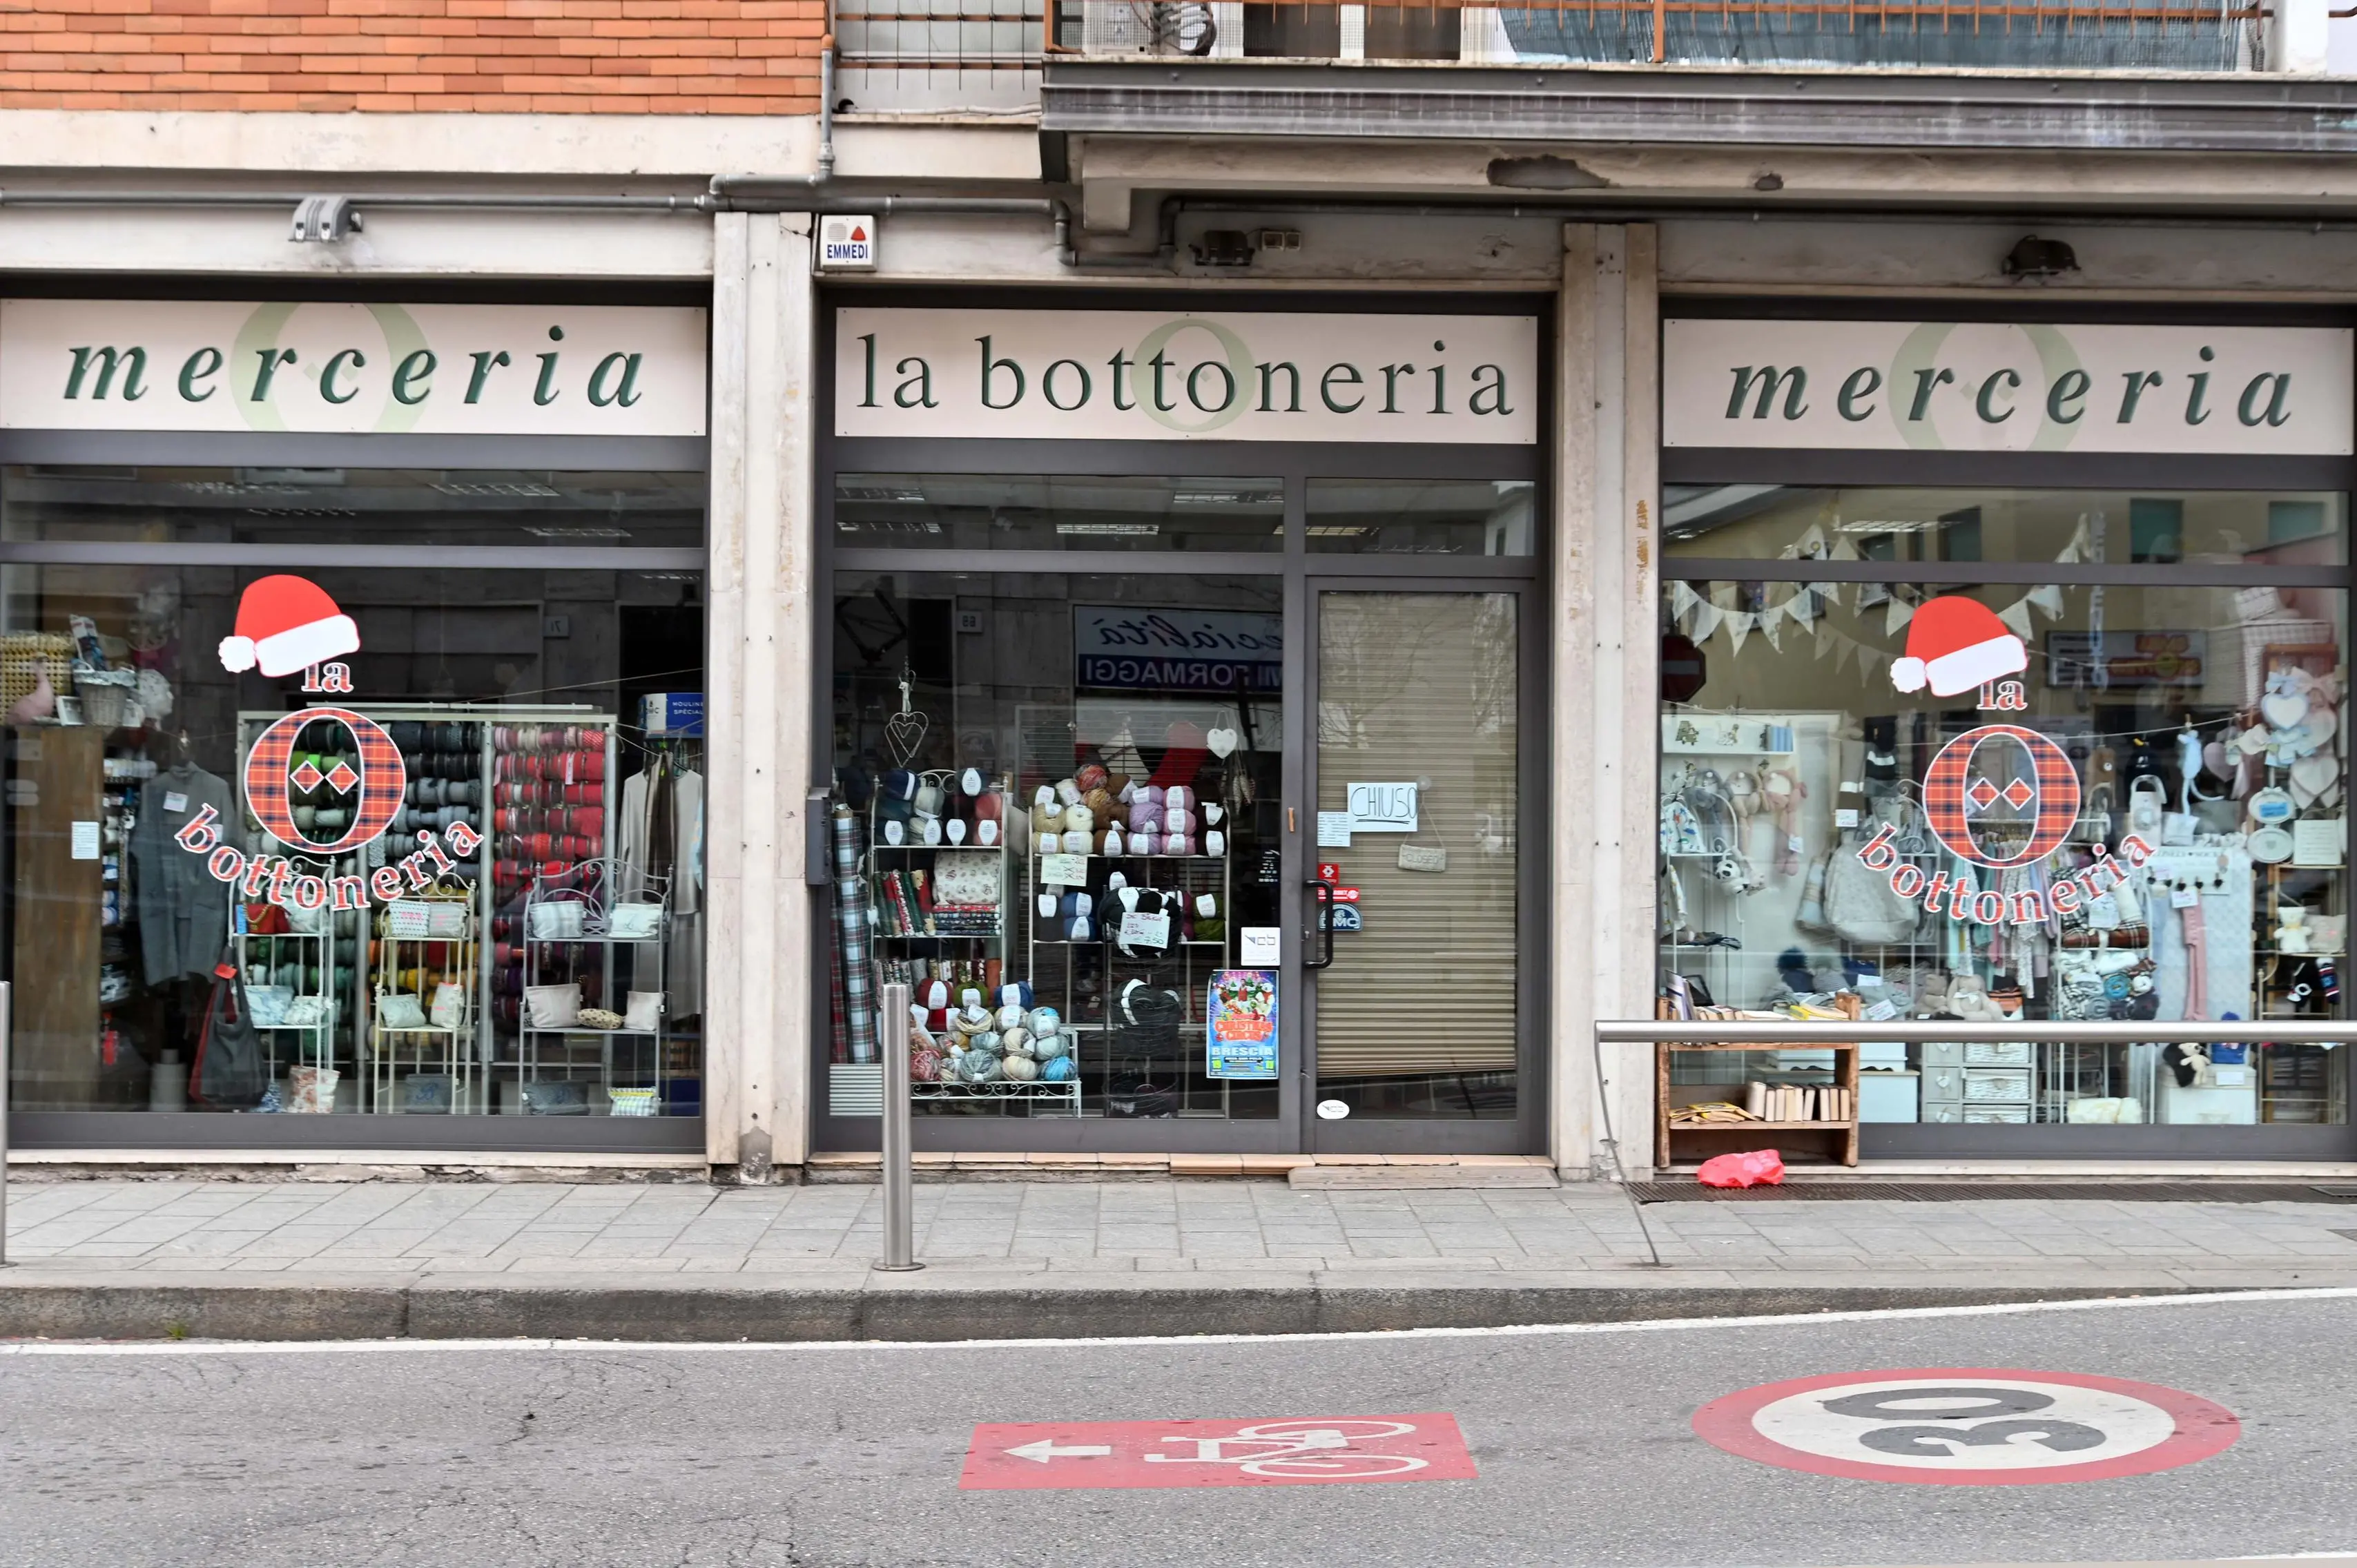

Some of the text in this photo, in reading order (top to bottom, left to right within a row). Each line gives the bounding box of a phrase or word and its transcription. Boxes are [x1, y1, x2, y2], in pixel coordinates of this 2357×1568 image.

[827, 244, 868, 259] EMMEDI
[64, 325, 642, 407] merceria
[857, 333, 1514, 414] la bottoneria
[1725, 346, 2291, 427] merceria
[301, 662, 353, 693] la
[1977, 680, 2028, 711] la
[1350, 786, 1417, 819] CHIUSO
[174, 802, 484, 912] bottoneria
[1856, 822, 2157, 926] bottoneria
[1212, 1047, 1274, 1056] BRESCIA
[1823, 1387, 2106, 1458] 30
